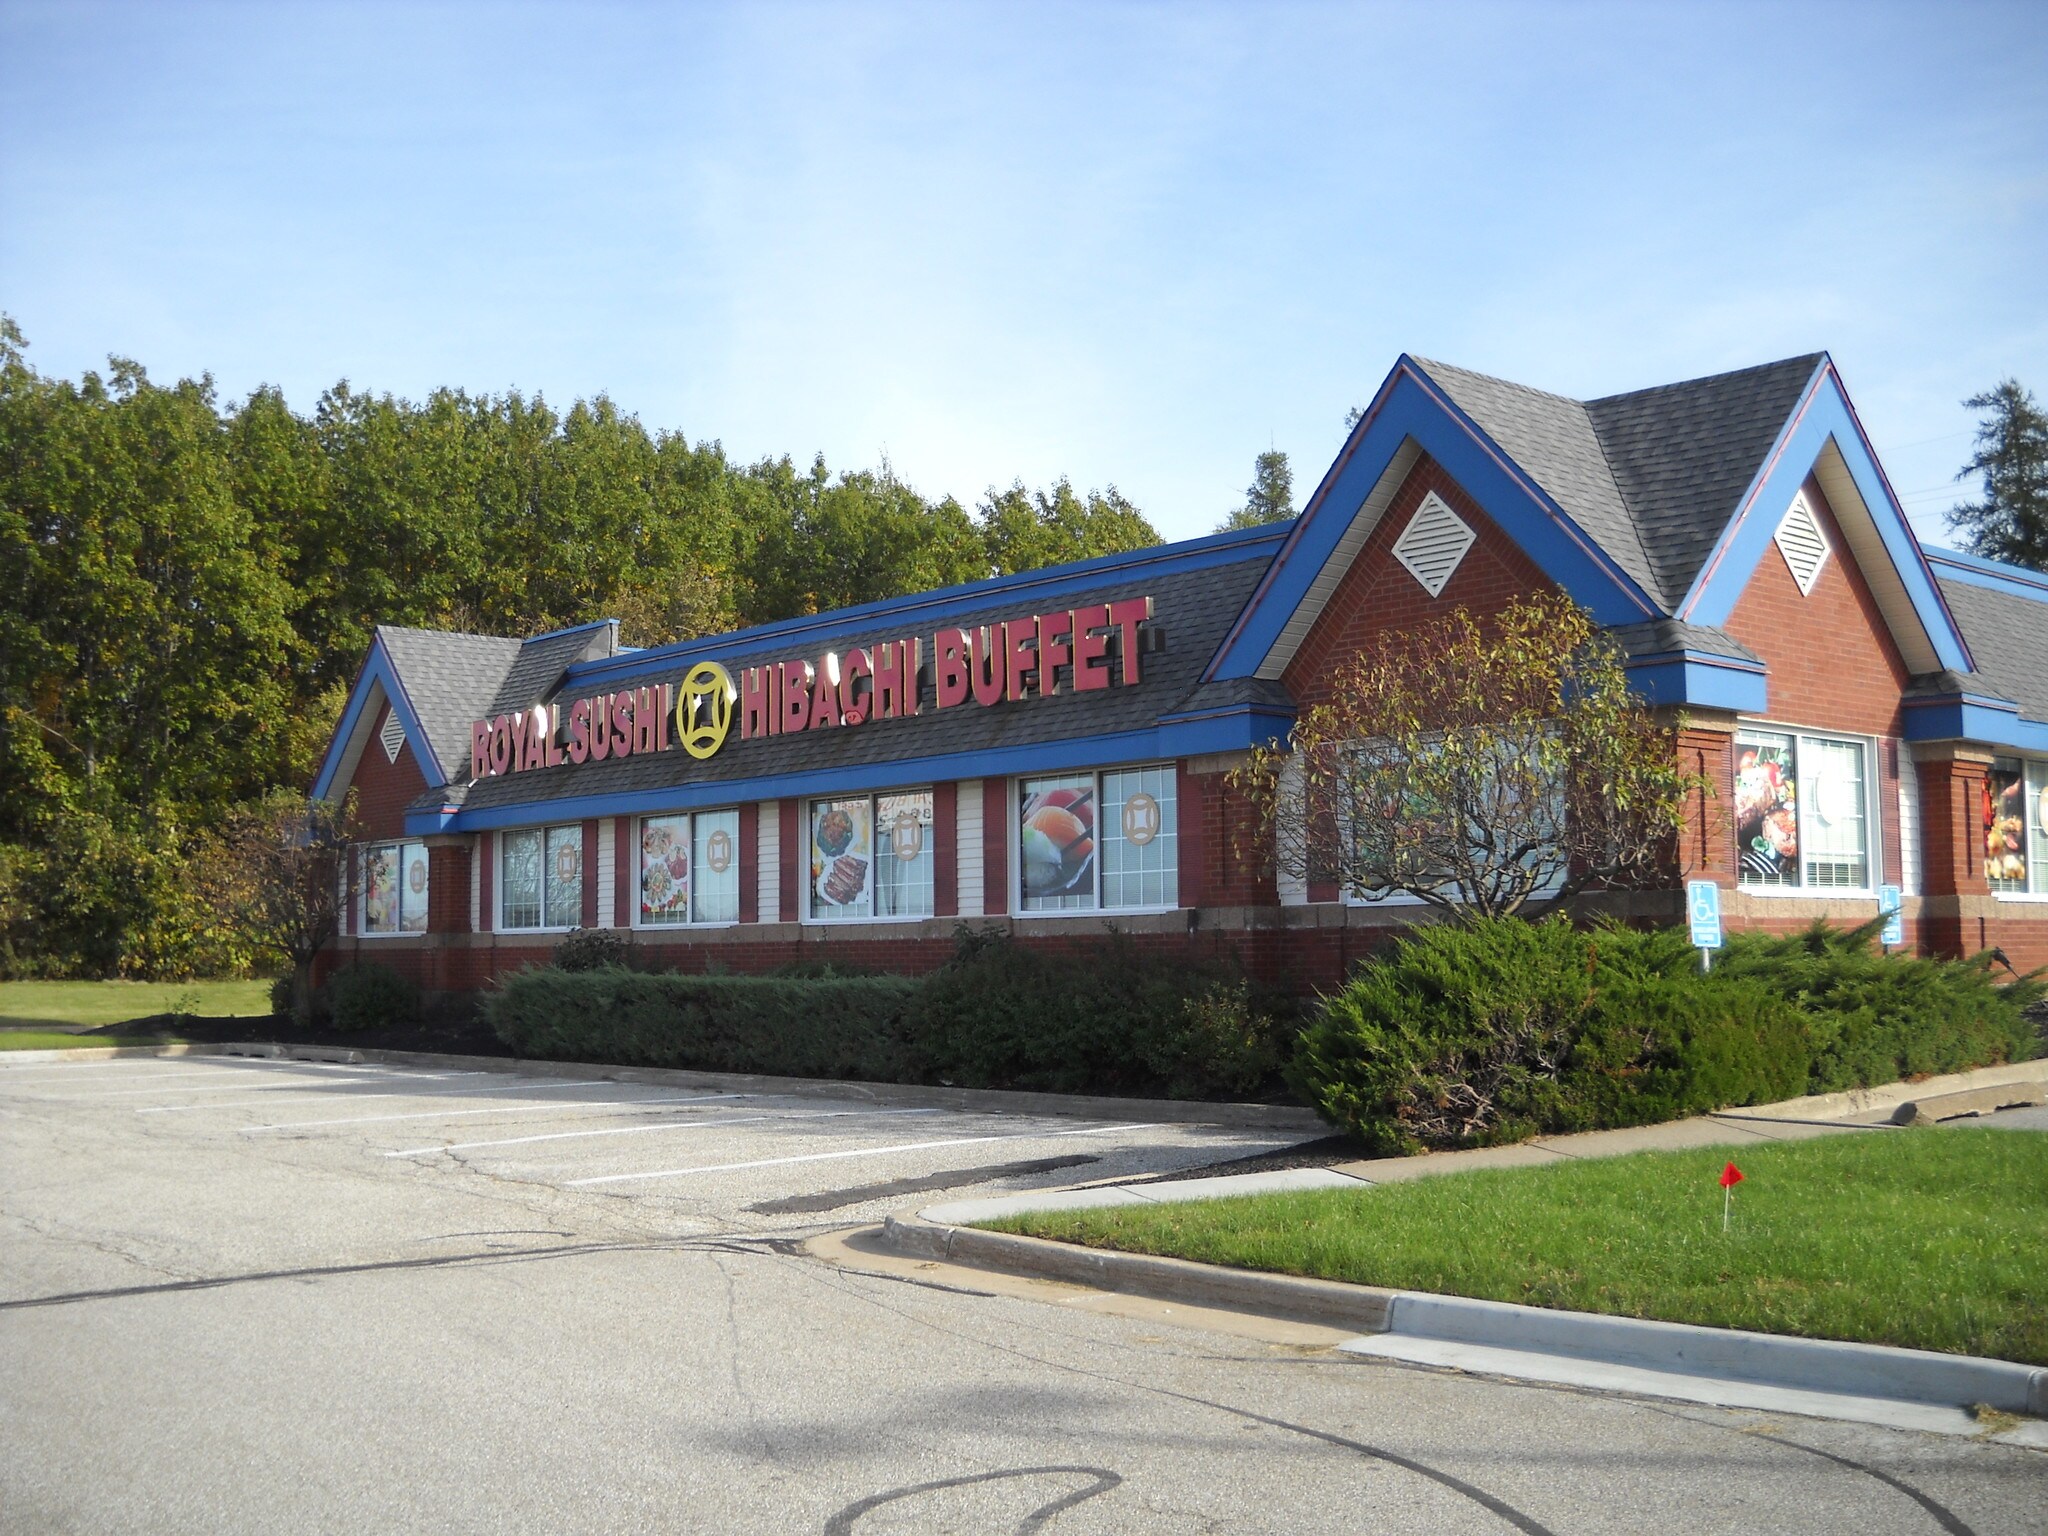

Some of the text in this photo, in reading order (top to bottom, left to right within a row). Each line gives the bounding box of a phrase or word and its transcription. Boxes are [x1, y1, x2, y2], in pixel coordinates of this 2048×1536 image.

[471, 596, 1153, 779] ROYAL SUSHI HIBACHI BUFFET
